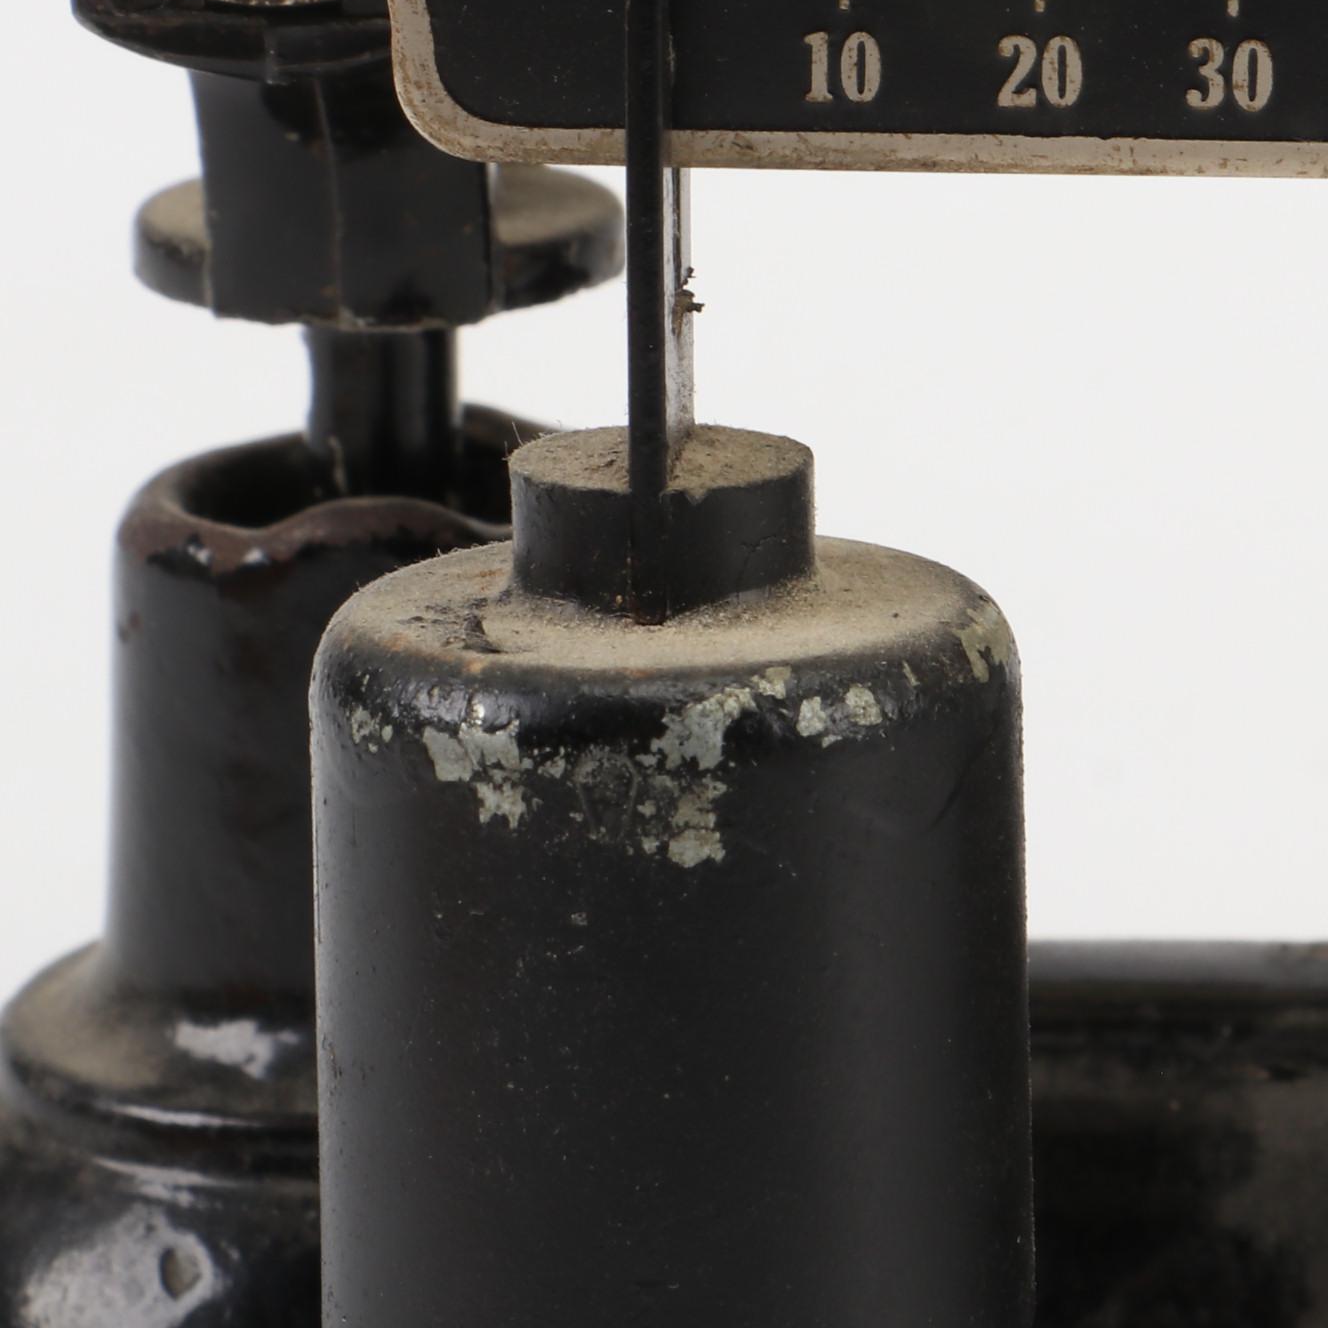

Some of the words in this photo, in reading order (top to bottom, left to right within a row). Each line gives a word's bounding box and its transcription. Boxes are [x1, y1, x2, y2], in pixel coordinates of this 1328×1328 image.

[807, 33, 883, 104] 10
[998, 36, 1083, 108] 20
[1186, 39, 1274, 112] 30
